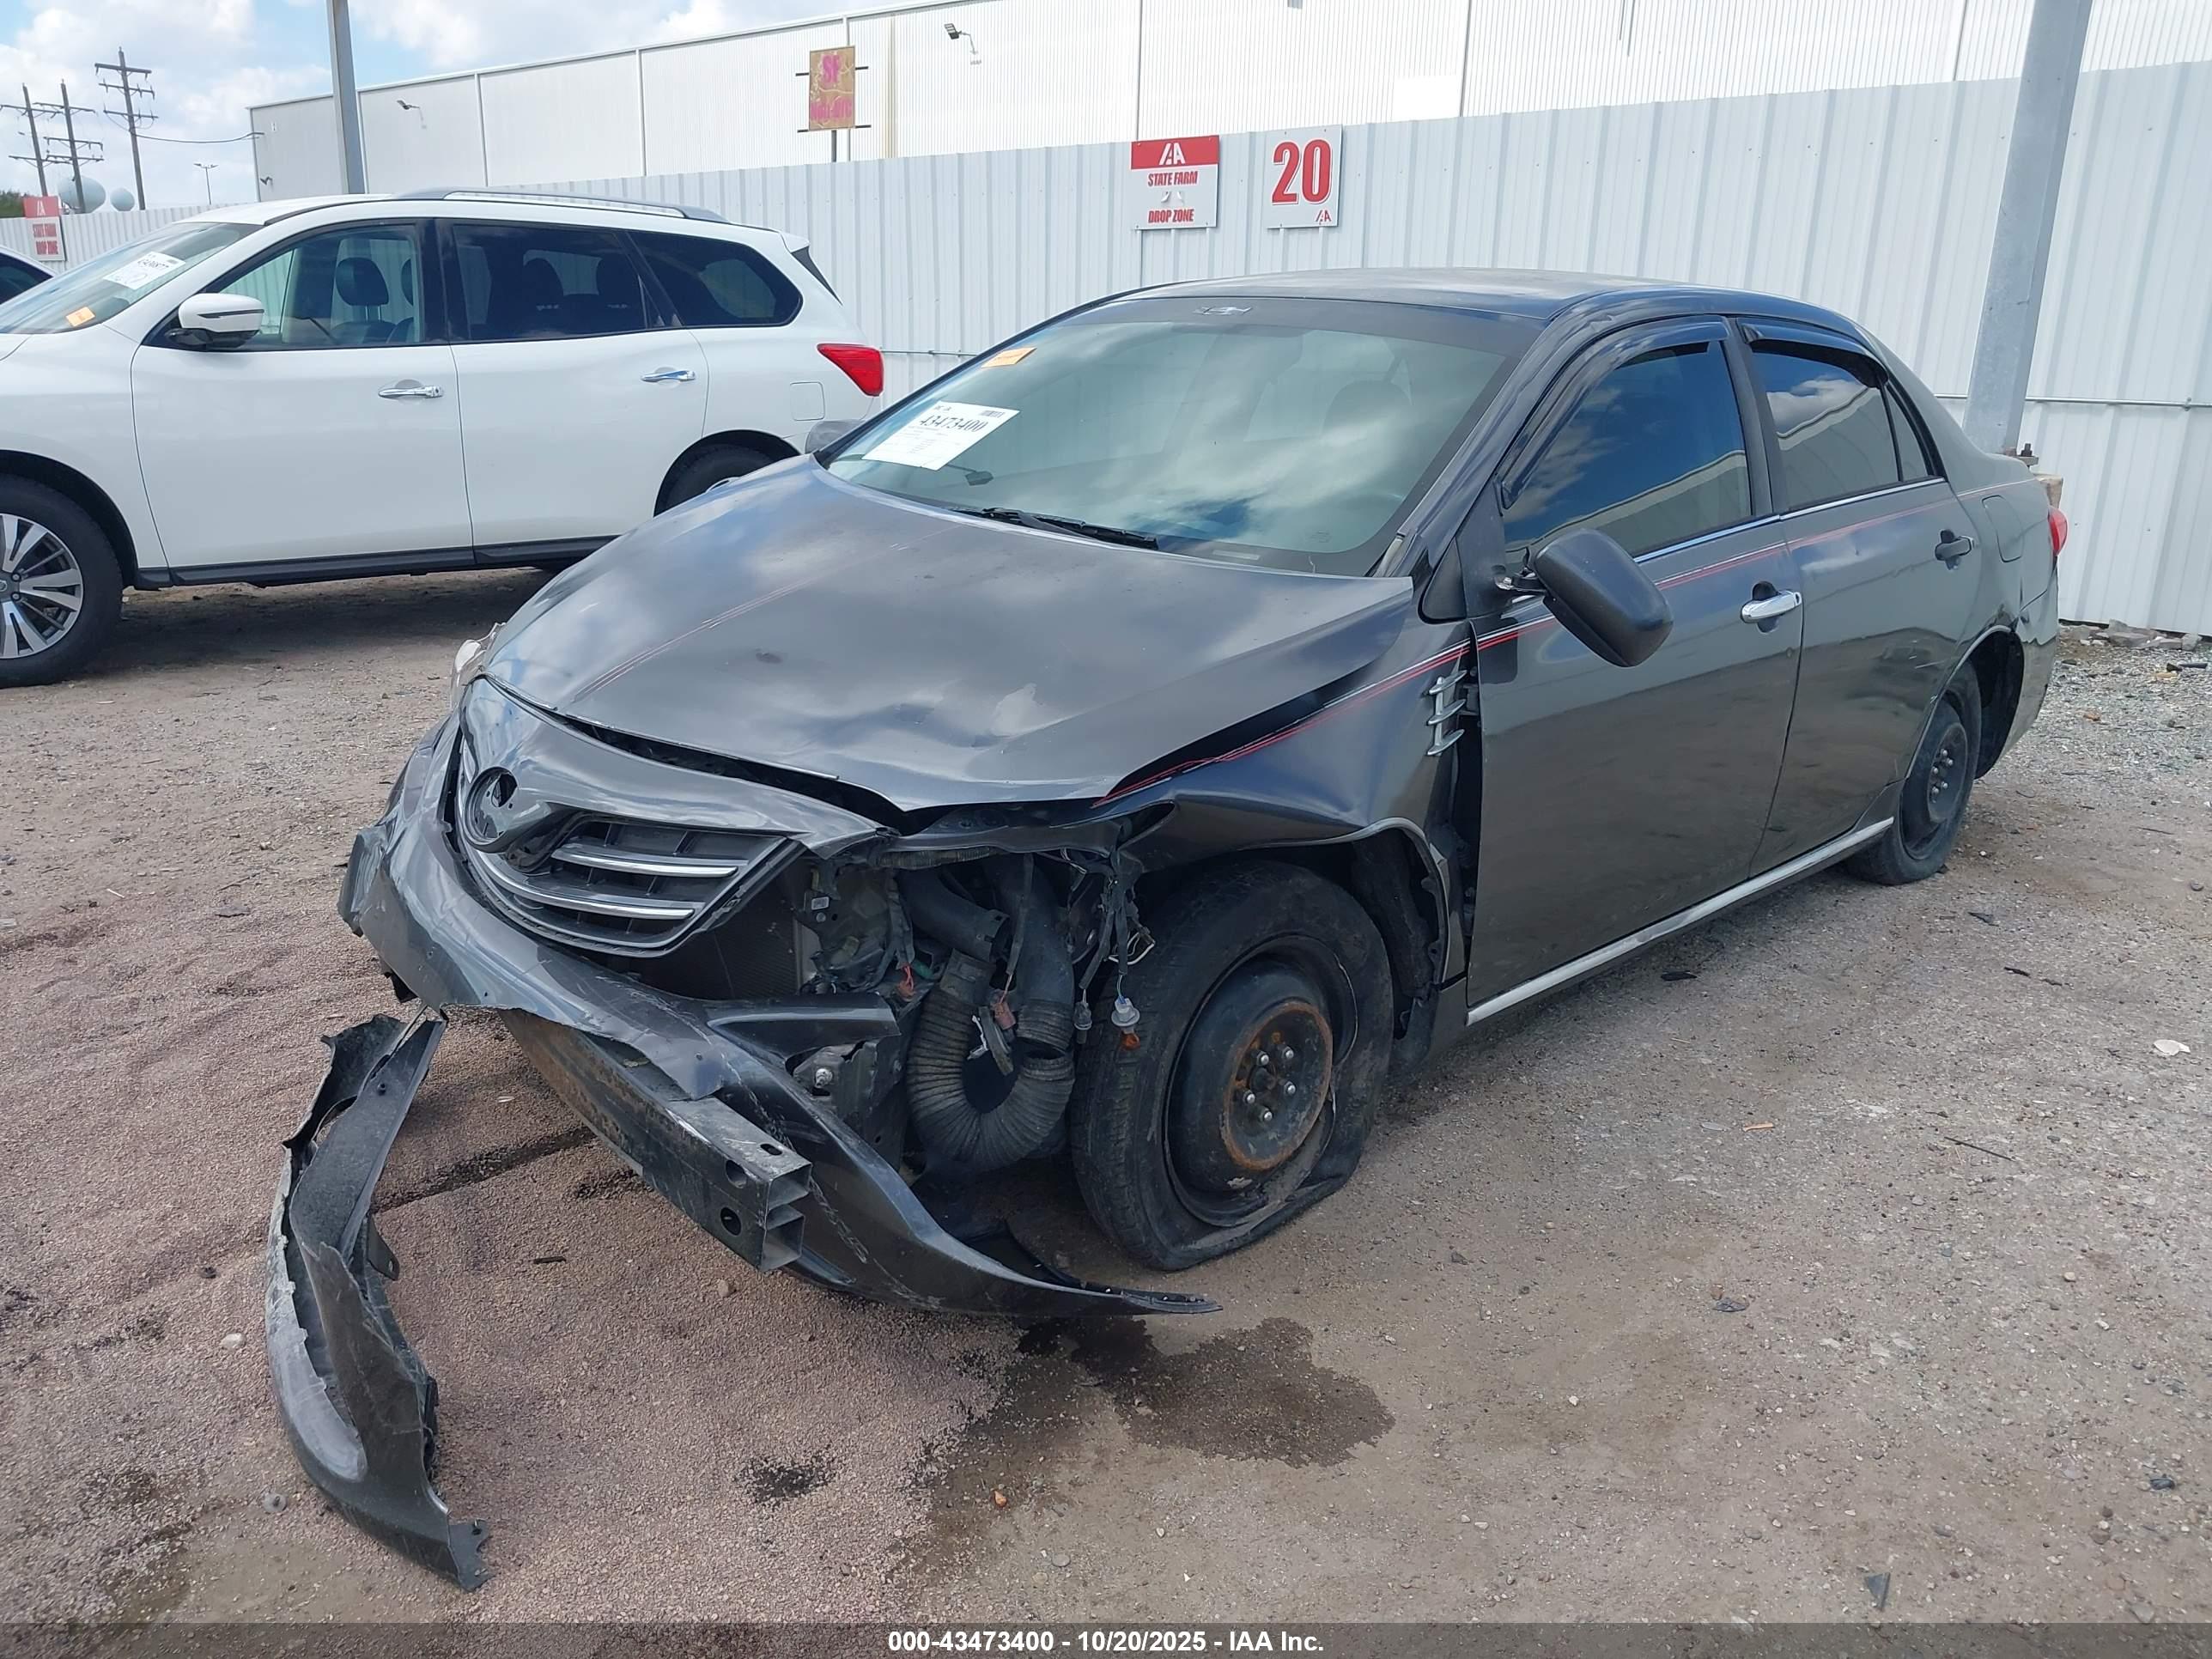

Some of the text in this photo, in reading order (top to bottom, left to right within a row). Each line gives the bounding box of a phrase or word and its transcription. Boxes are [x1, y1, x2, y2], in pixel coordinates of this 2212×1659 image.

[1147, 171, 1198, 187] STATE FARM
[1272, 139, 1332, 204] 20
[1147, 209, 1194, 223] DROP ZONE
[919, 415, 988, 432] 43473400
